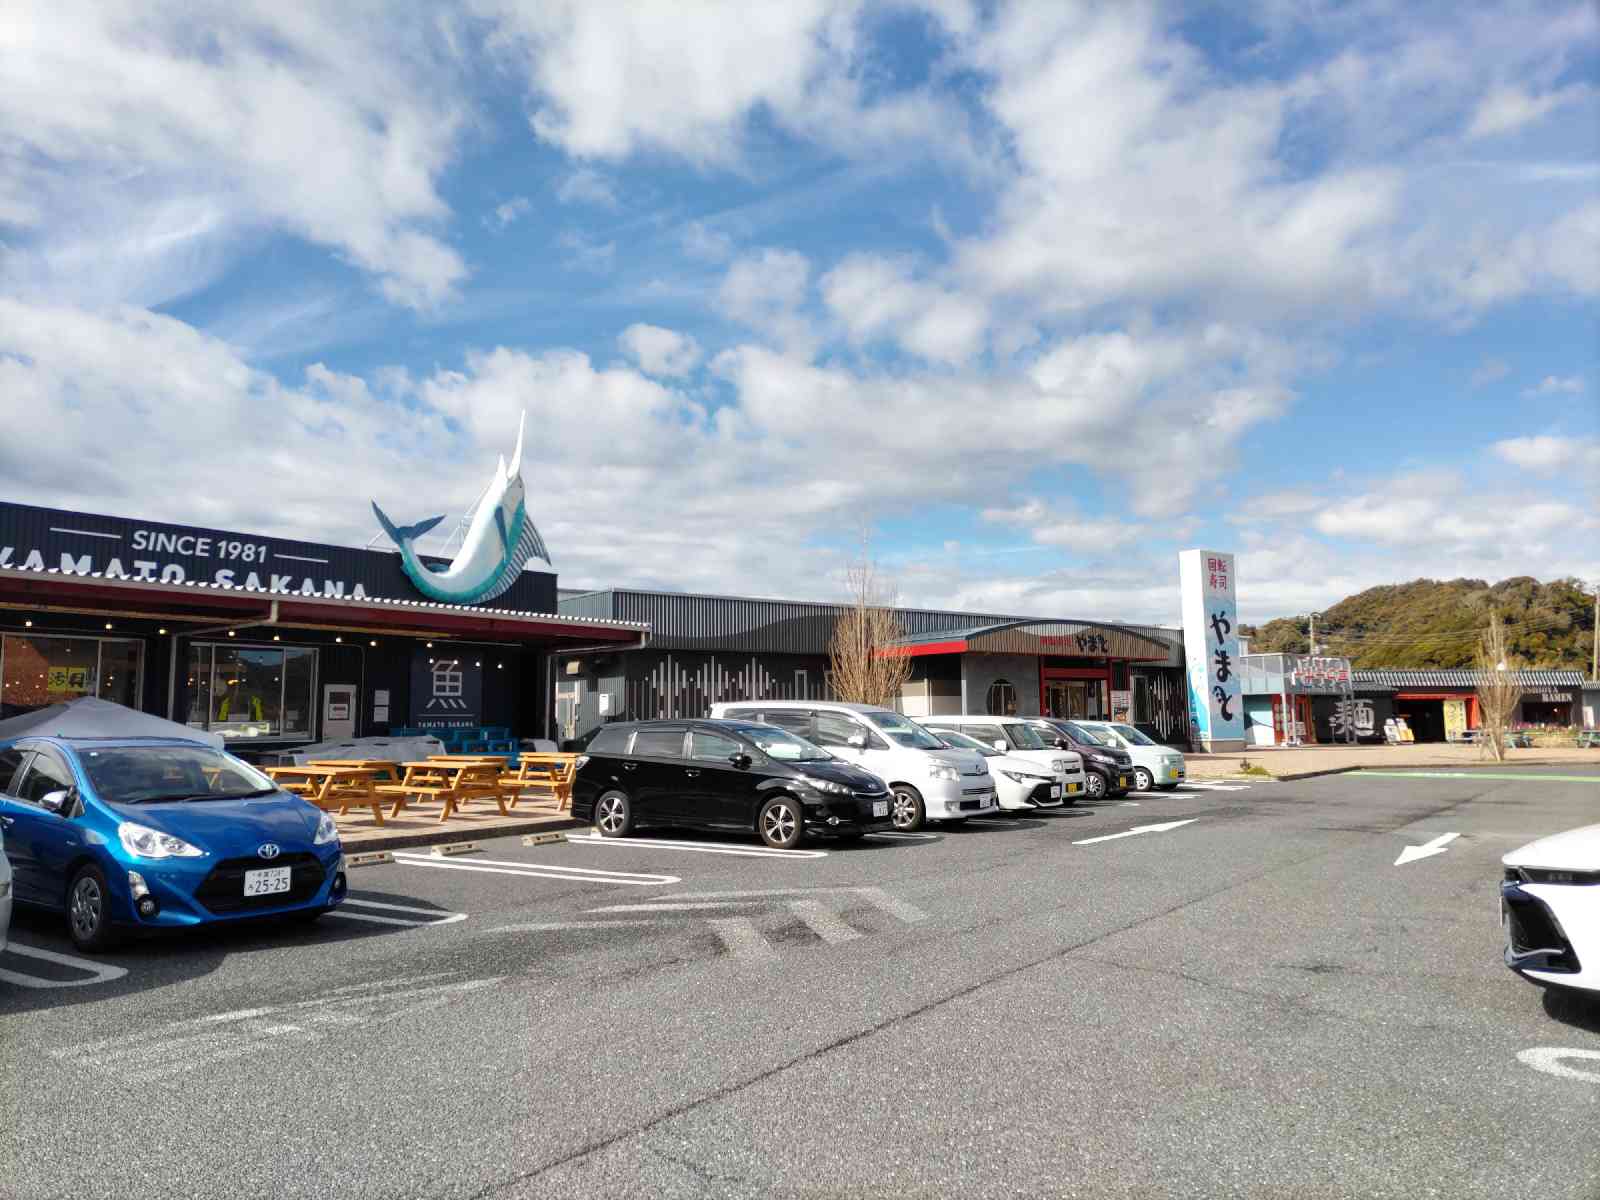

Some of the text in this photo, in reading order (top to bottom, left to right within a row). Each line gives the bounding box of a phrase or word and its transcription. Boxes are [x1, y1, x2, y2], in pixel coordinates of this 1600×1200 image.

[132, 530, 267, 563] SINCE 1981
[1208, 558, 1228, 573] 回転
[215, 569, 368, 599] SAKANA
[1209, 575, 1228, 590] 寿司
[1210, 611, 1233, 722] やまと
[1541, 693, 1573, 702] RAMEN
[255, 877, 289, 893] 25-25
